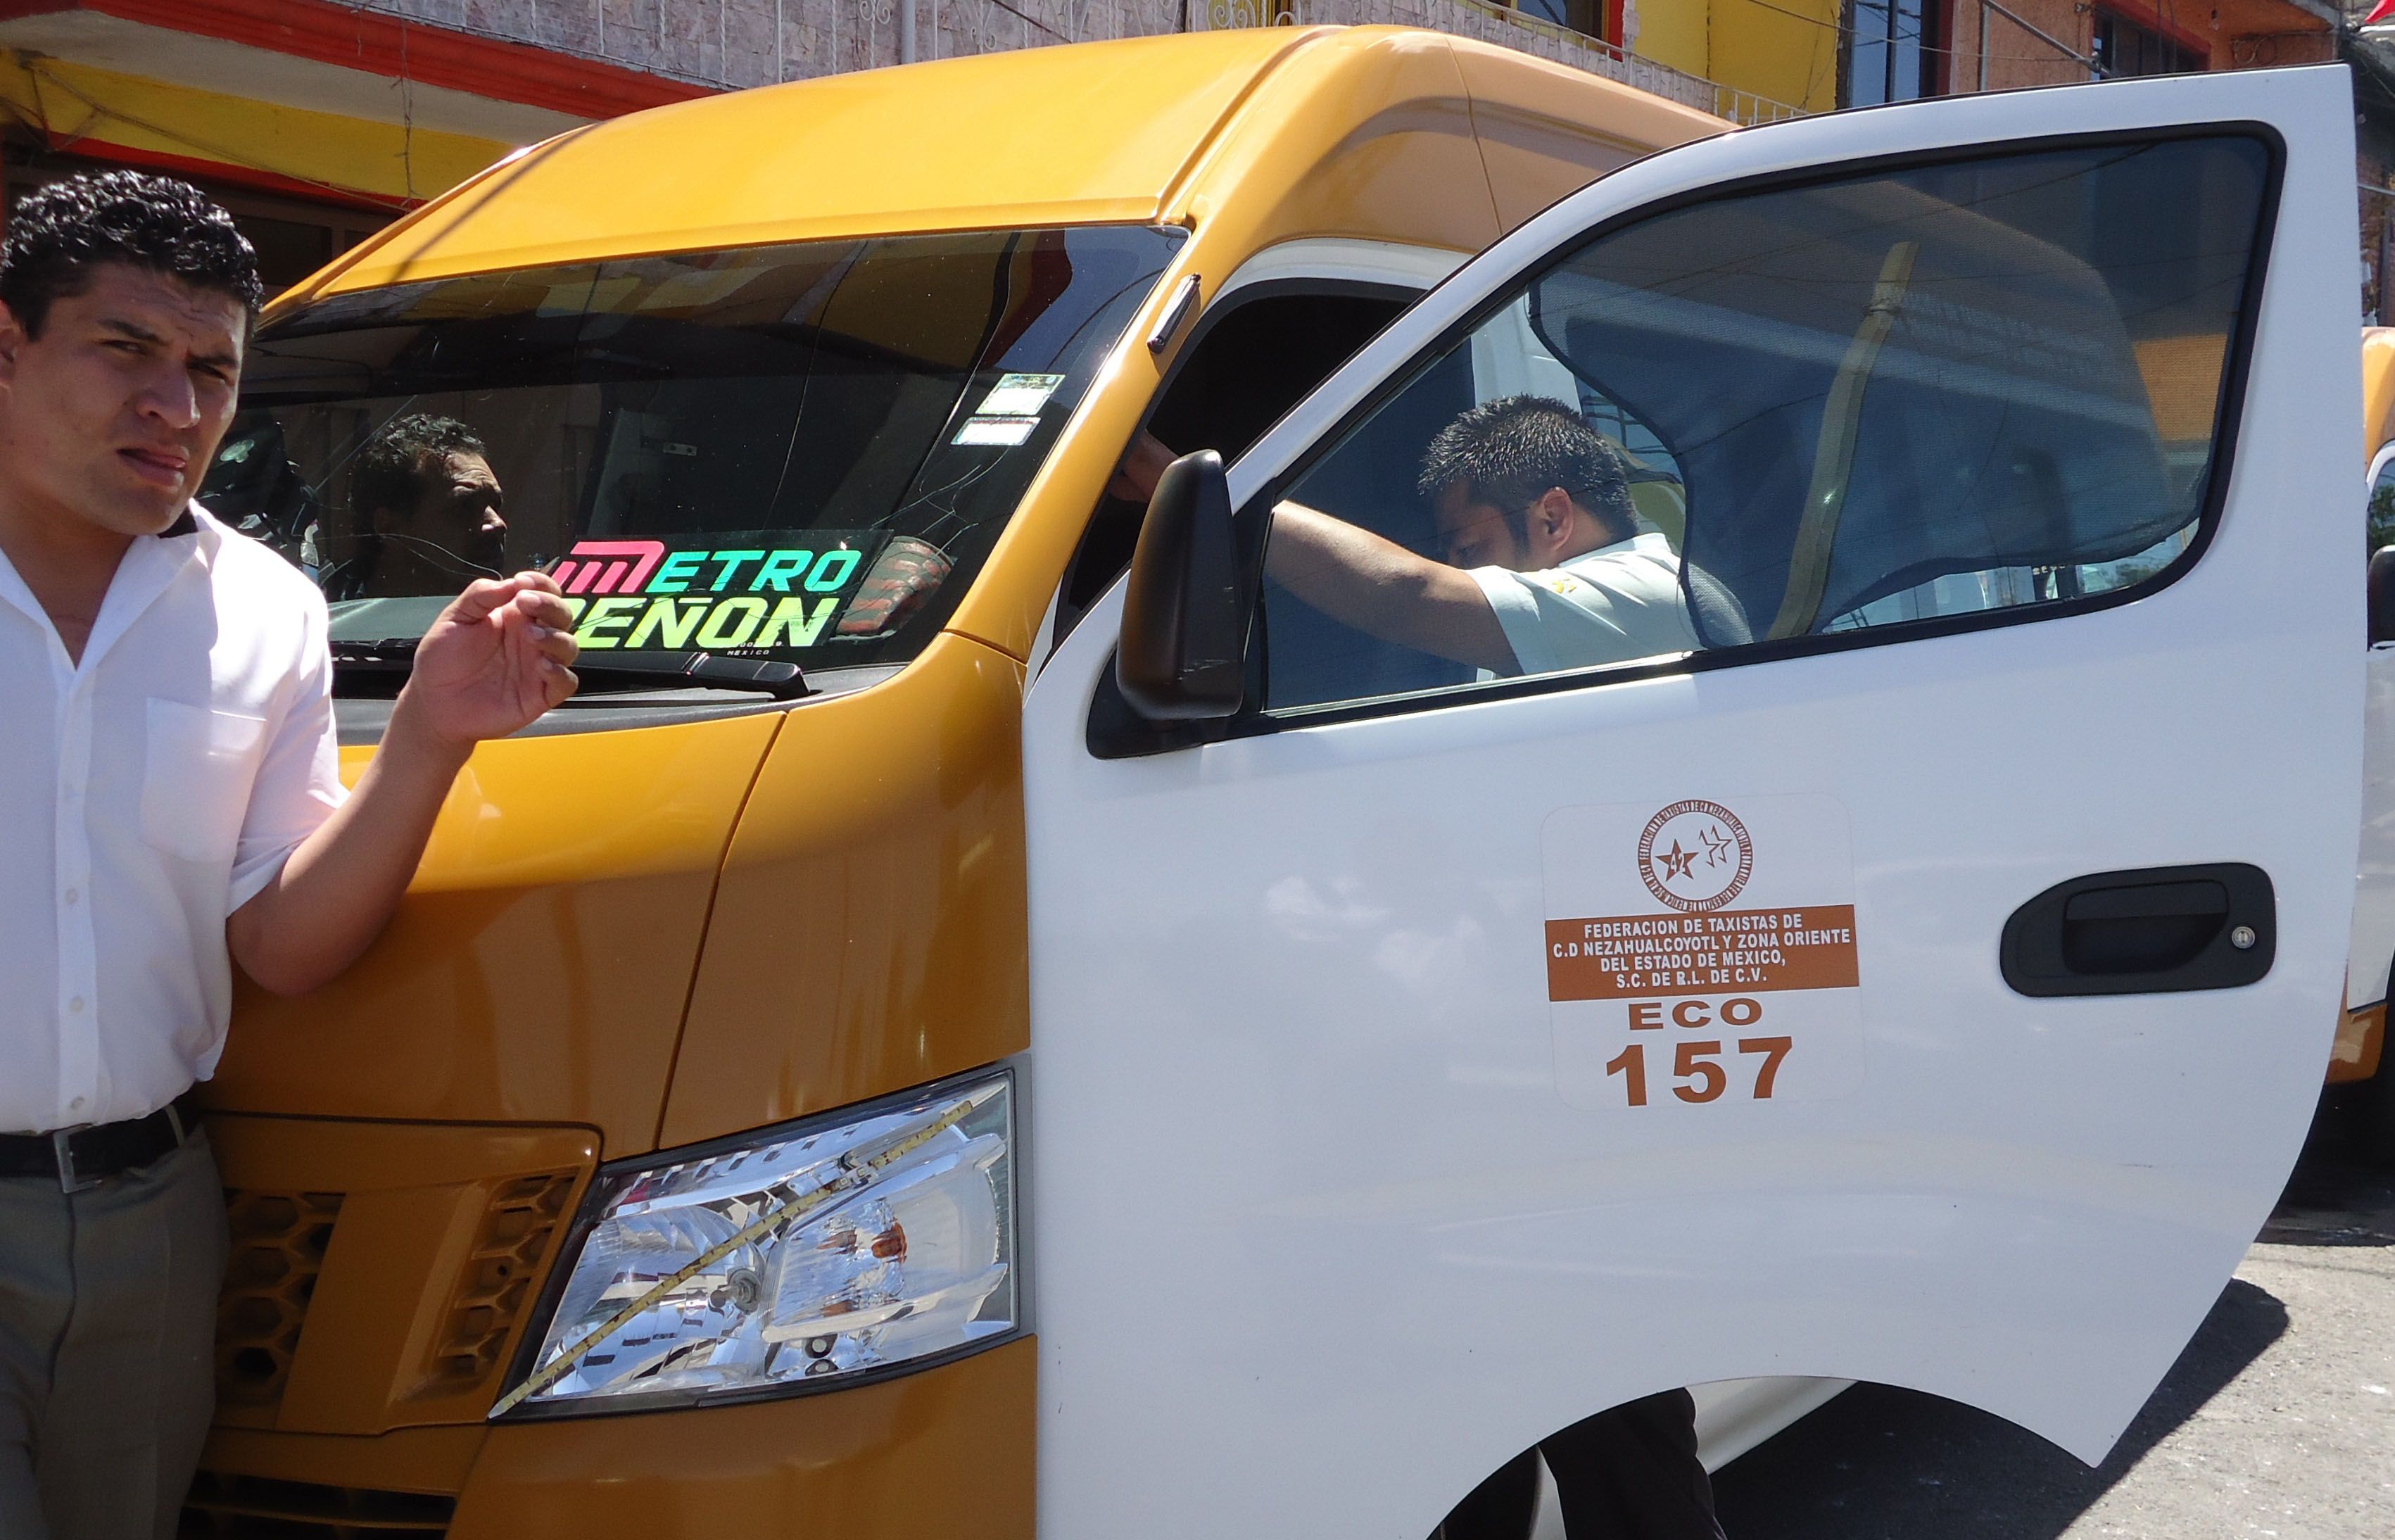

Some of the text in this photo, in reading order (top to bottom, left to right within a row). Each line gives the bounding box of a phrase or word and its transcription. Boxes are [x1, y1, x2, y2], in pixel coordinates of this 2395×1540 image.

[551, 541, 861, 593] METRO
[1670, 852, 1686, 873] 42
[1584, 914, 1802, 938] FEDERACION DE TAXISTAS DE
[1553, 928, 1850, 958] C.D NEZAHUALCOYOTL Y ZONA ORIENTE
[1600, 949, 1786, 972] DEL ESTADO DE MEXICO,
[1616, 967, 1767, 989] S.C. DE R.L. DE C.V.
[1628, 997, 1762, 1030] ECO
[1606, 1035, 1793, 1106] 157
